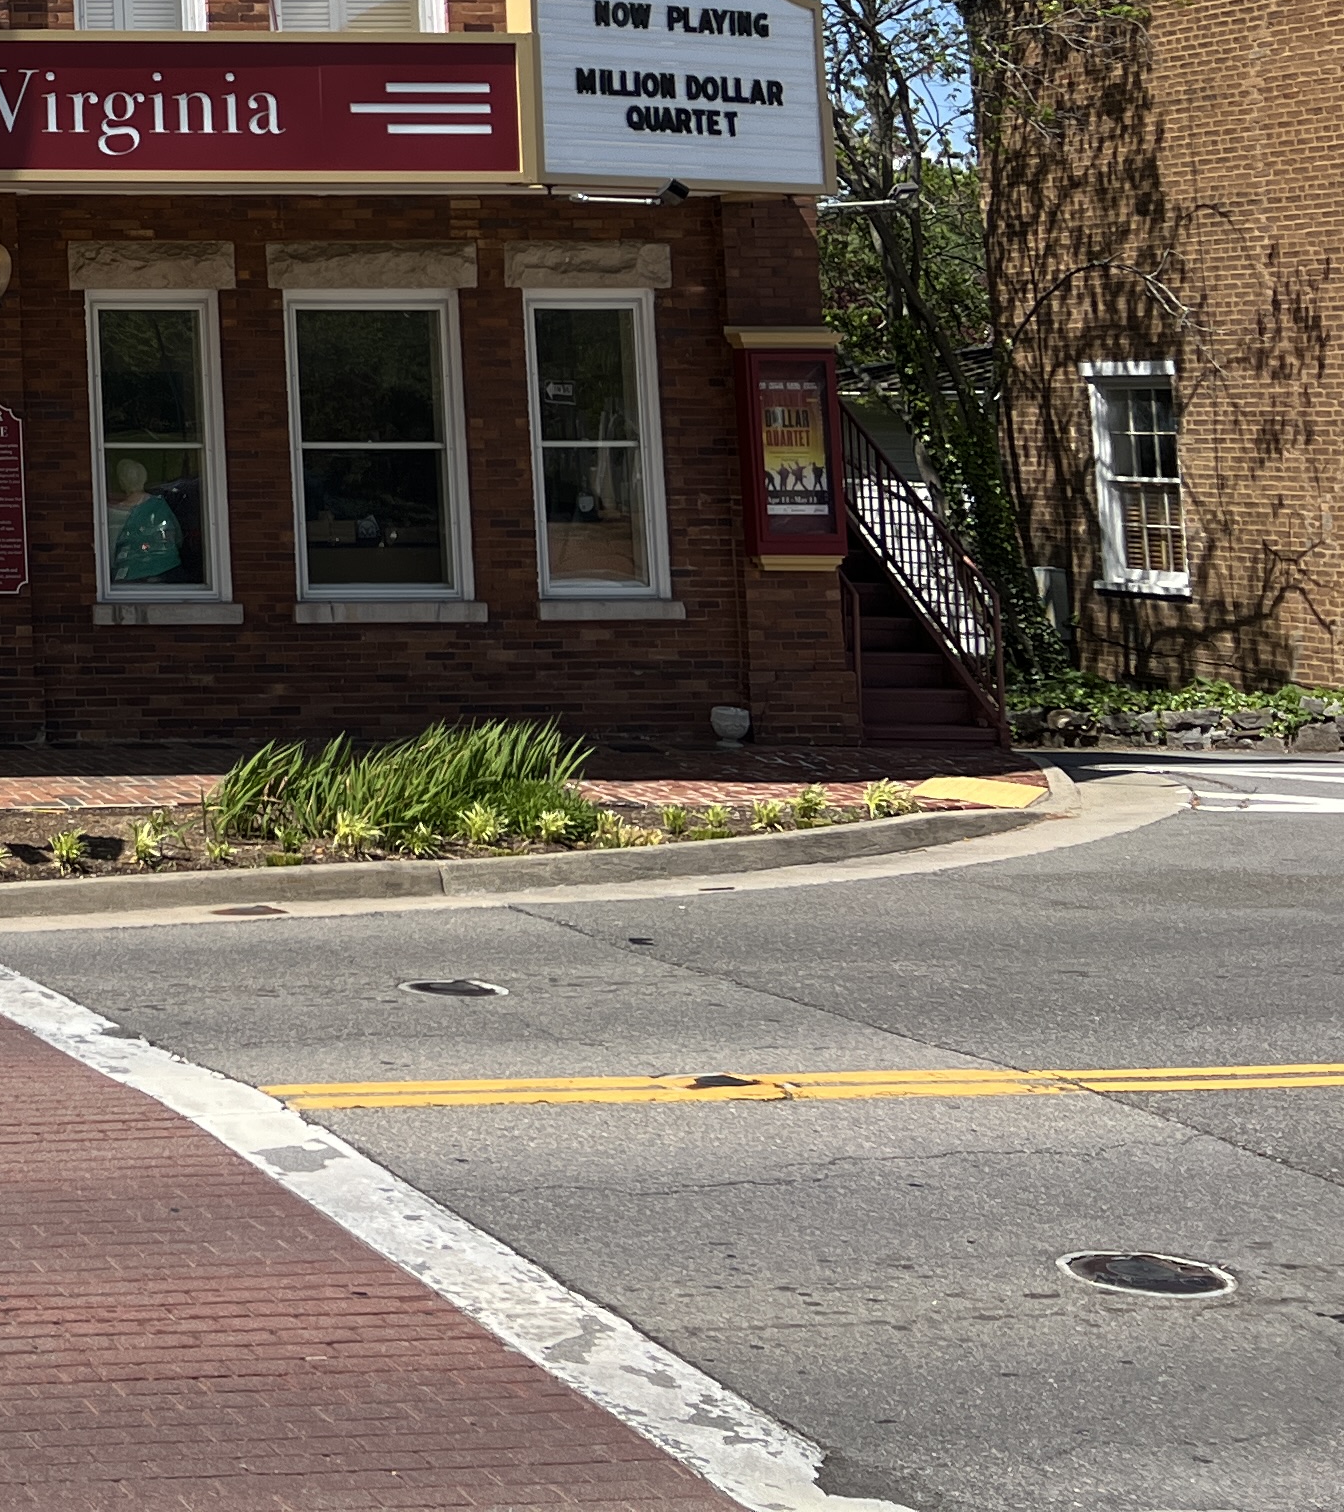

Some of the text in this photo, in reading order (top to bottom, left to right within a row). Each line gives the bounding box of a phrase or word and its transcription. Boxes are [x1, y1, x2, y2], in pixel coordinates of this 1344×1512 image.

[593, 0, 770, 38] NOW PLAYING
[575, 67, 784, 107] MILLION DOLLAR
[625, 105, 739, 137] QUARTET
[765, 430, 811, 448] QUARTET
